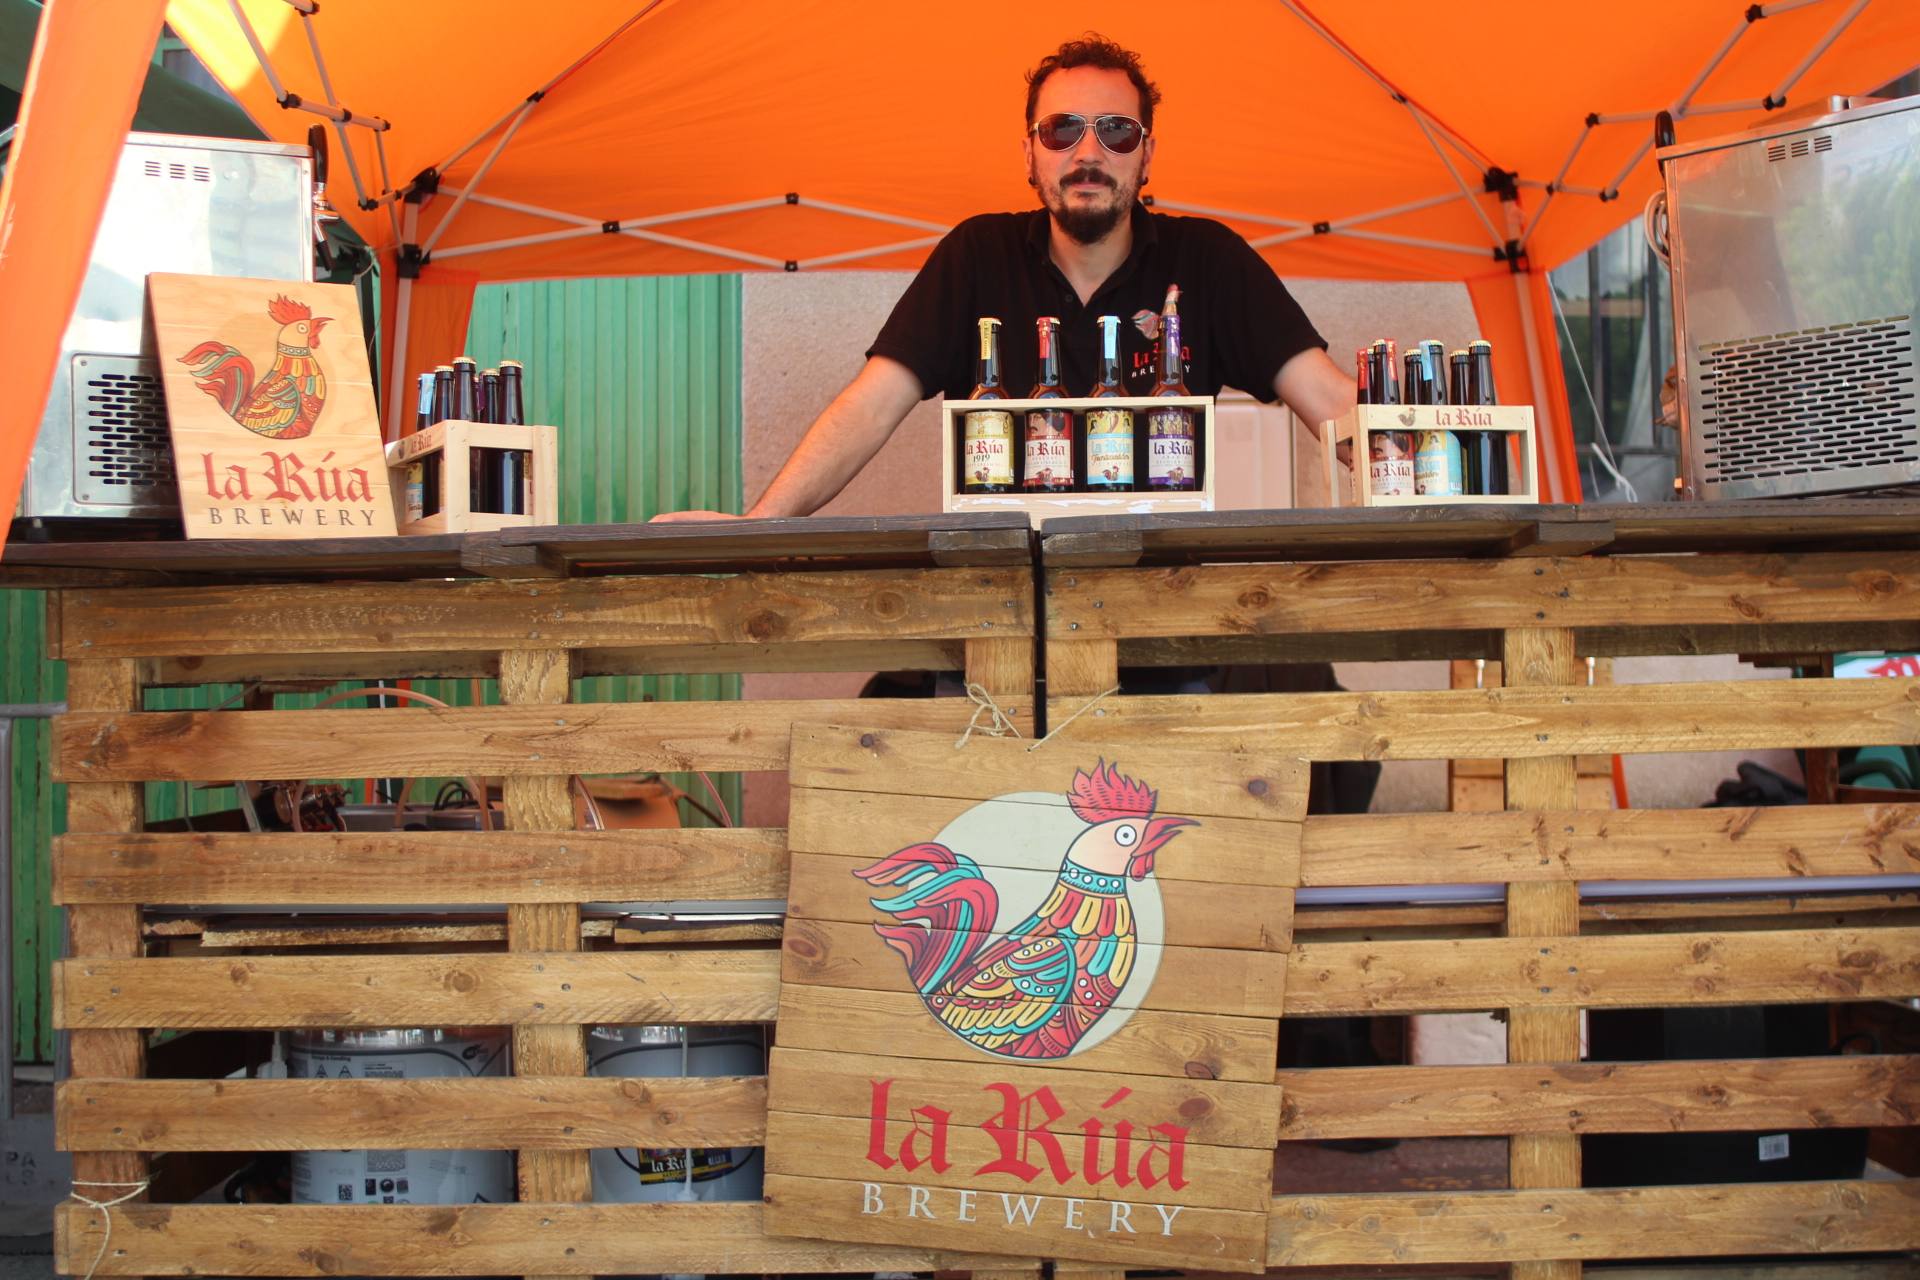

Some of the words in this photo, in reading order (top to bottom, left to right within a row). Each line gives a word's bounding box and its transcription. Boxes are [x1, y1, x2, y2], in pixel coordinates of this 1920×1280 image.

[1131, 364, 1191, 379] BREY
[1435, 409, 1451, 426] la
[1456, 407, 1493, 427] Rúa
[976, 440, 1004, 454] Rúa
[1036, 441, 1065, 456] Rúa
[1154, 441, 1165, 455] la
[1168, 440, 1193, 455] Rúa
[200, 452, 253, 501] la
[261, 451, 376, 503] Rúa
[1383, 462, 1410, 478] Rúa
[208, 507, 377, 526] BREWERY
[865, 1077, 953, 1174] la
[973, 1081, 1190, 1191] Rúa
[651, 1159, 664, 1173] la
[861, 1182, 1185, 1237] BREWERY
